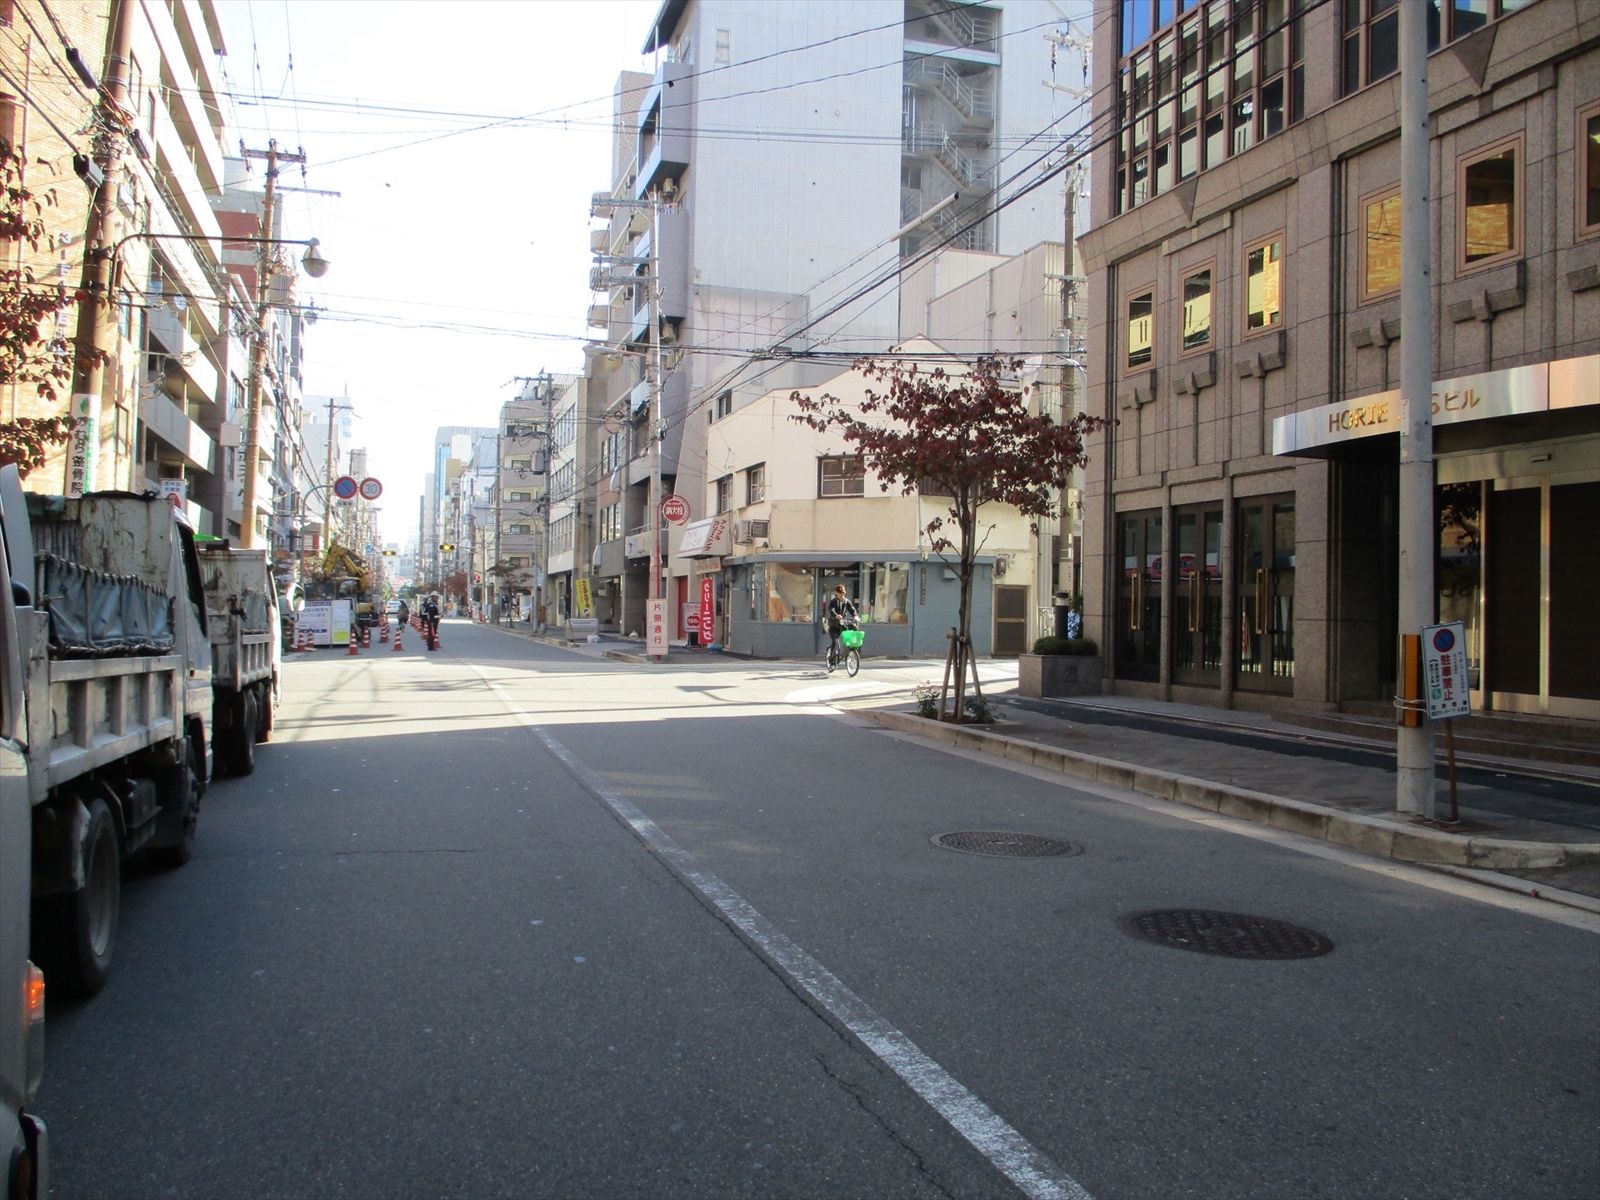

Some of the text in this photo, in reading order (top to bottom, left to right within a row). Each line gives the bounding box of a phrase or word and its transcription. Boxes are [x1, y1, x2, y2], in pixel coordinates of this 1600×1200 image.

[1328, 400, 1390, 433] HORIE
[364, 483, 379, 495] 30
[665, 506, 684, 515] 消火栓
[704, 519, 720, 552] クリーニング
[654, 602, 662, 645] 片側通行
[703, 582, 712, 640] クリーニング
